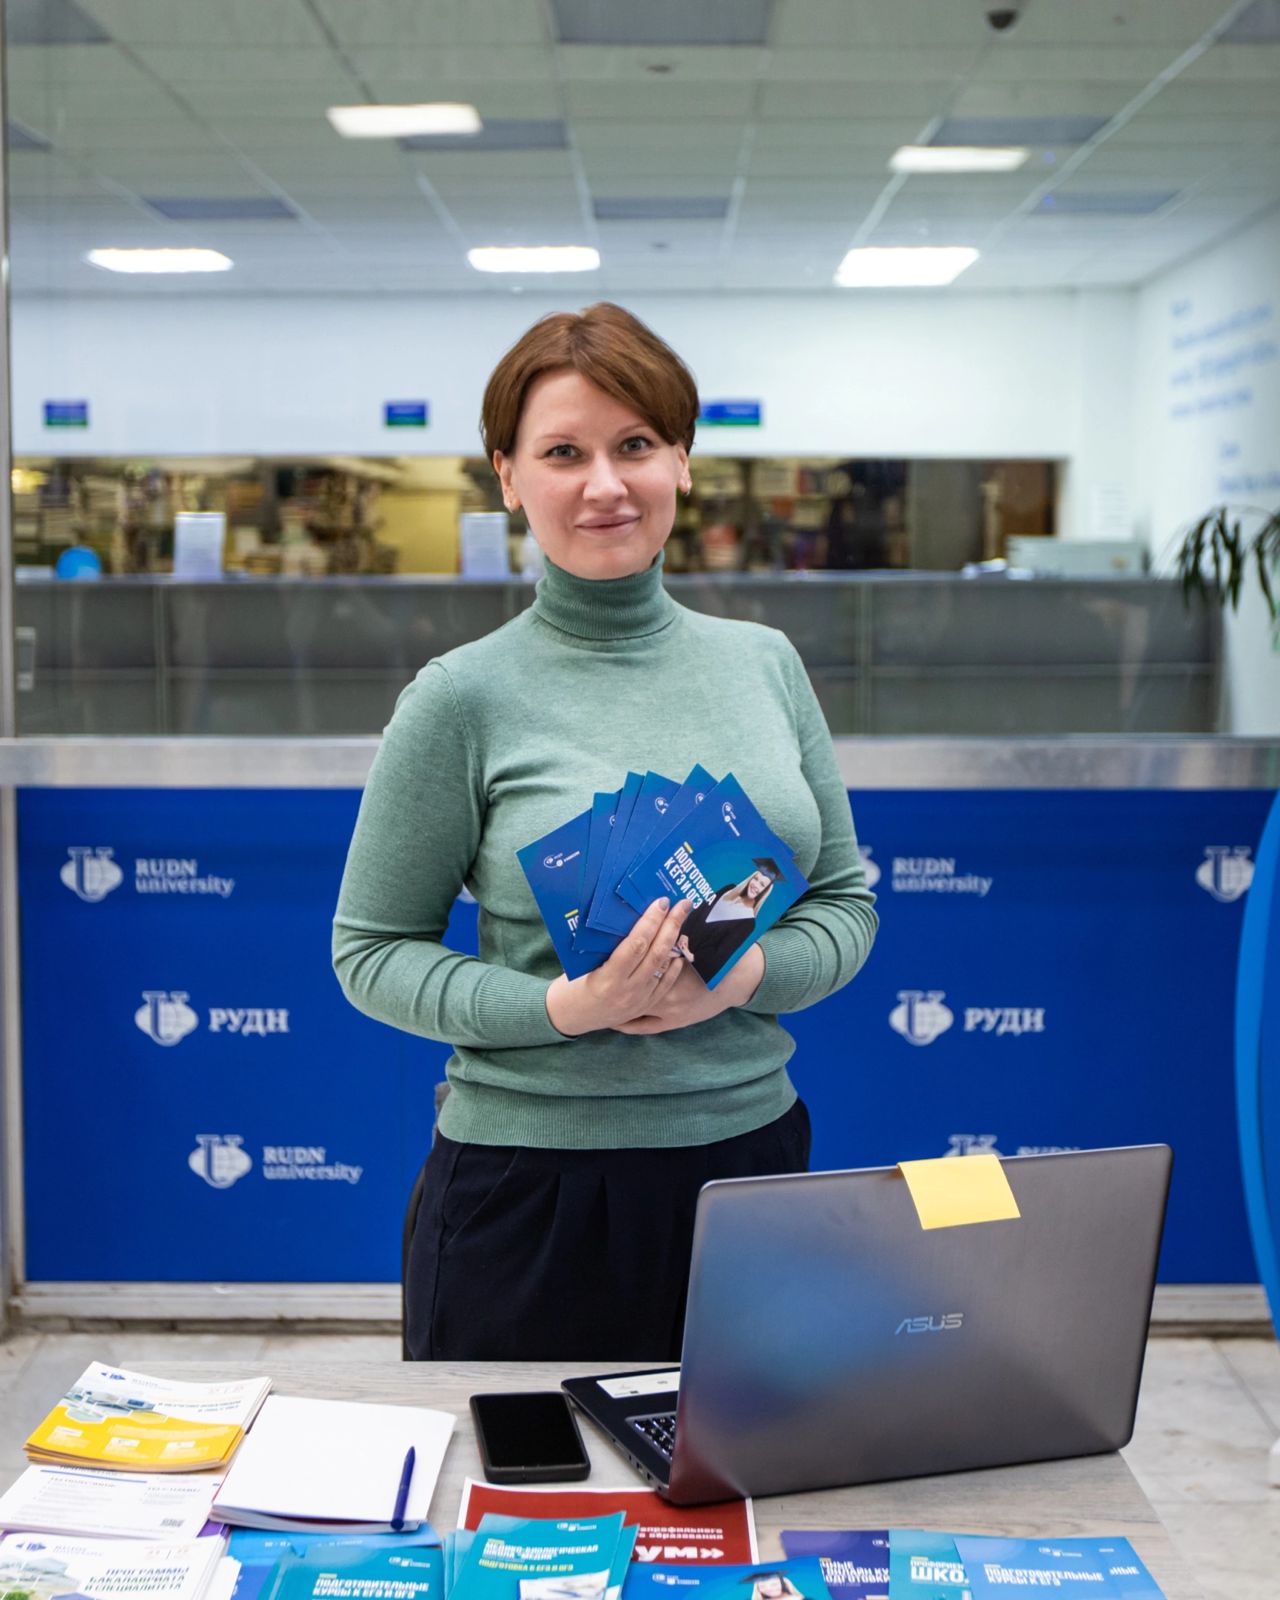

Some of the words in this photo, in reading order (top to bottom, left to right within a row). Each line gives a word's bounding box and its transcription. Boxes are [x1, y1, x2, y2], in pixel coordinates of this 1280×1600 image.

[135, 858, 197, 876] RUDN
[664, 856, 676, 870] К
[893, 857, 955, 875] RUDN
[135, 873, 235, 898] university
[669, 864, 687, 886] ЕГЭ
[674, 846, 717, 906] ПОДГОТОВКА
[892, 873, 993, 898] university
[680, 880, 692, 894] И
[686, 888, 704, 909] ОГЭ
[208, 1007, 290, 1037] РУДН
[963, 1007, 1046, 1037] РУДН
[263, 1146, 326, 1165] RUDN
[262, 1162, 363, 1185] university
[894, 1313, 964, 1335] ASUS
[911, 1567, 969, 1584] ШКО
